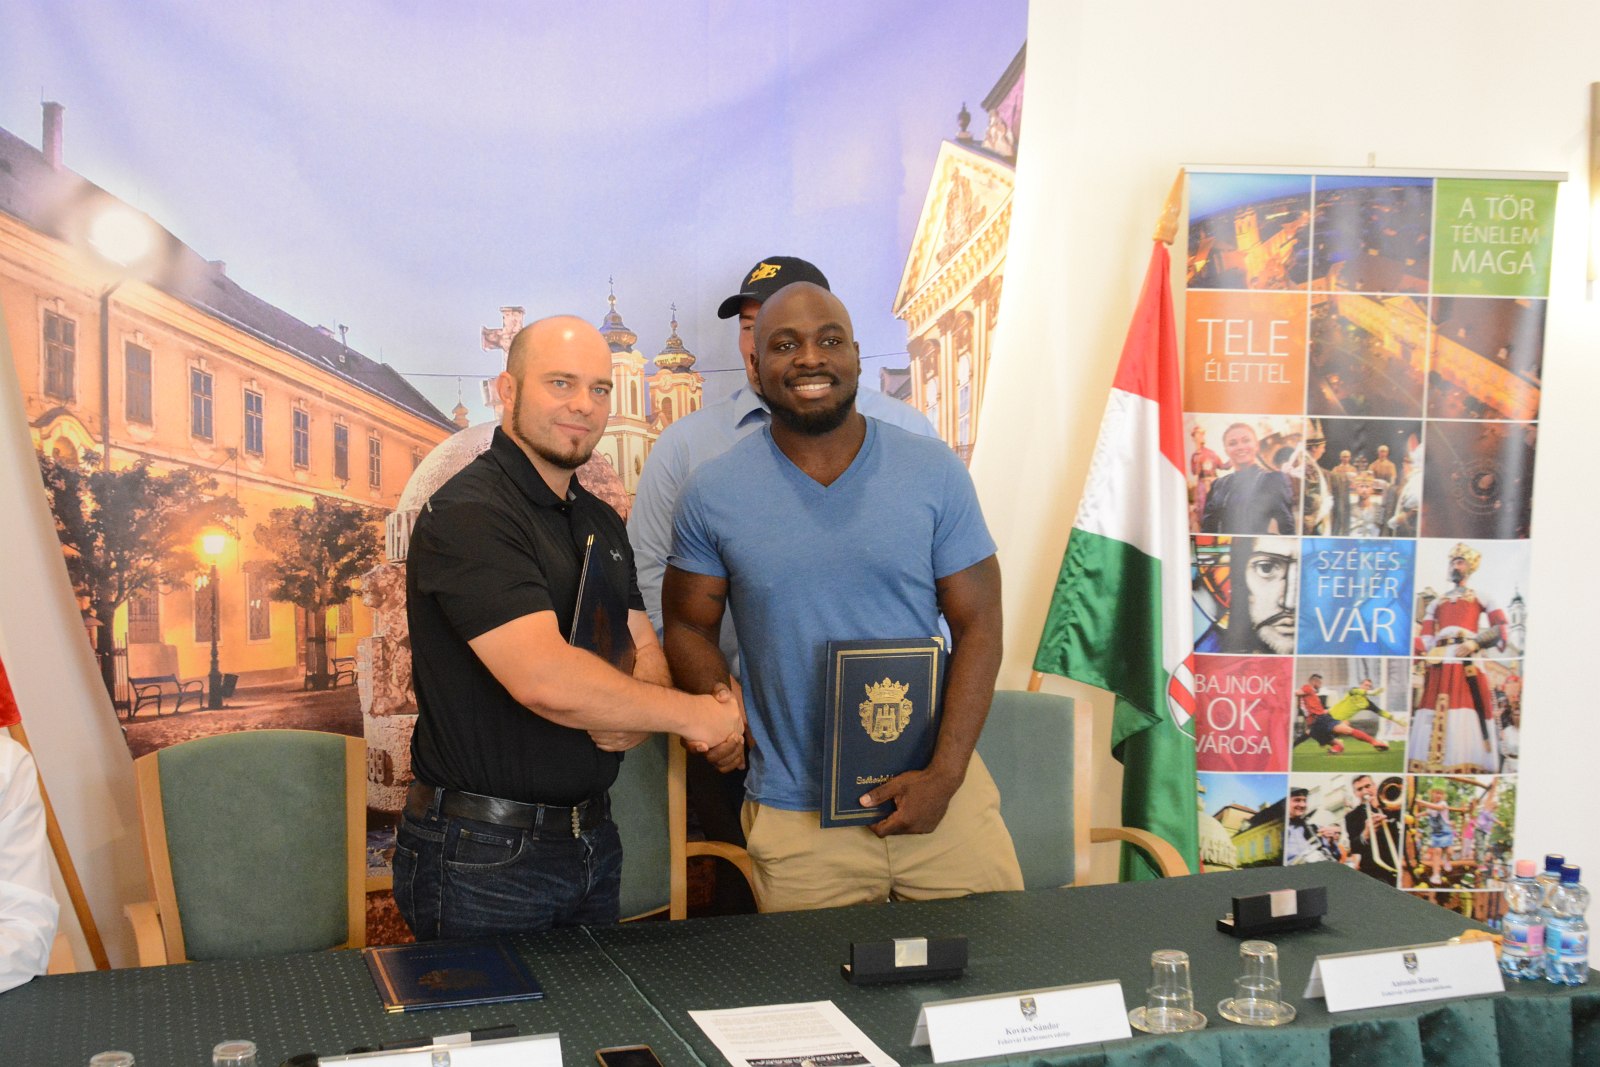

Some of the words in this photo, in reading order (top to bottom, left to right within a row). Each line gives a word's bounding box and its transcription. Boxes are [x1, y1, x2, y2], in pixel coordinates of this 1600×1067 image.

[1458, 197, 1476, 220] A
[1450, 222, 1539, 245] TÉNELEM
[1451, 248, 1536, 275] MAGA
[1196, 318, 1290, 357] TELE
[1204, 358, 1291, 384] ÉLETTEL
[1317, 547, 1401, 571] SZÉKES
[1317, 572, 1399, 599] FEHÉR
[1314, 599, 1397, 643] VÁR
[1194, 673, 1277, 695] BAJNOK
[1206, 696, 1262, 732] OK
